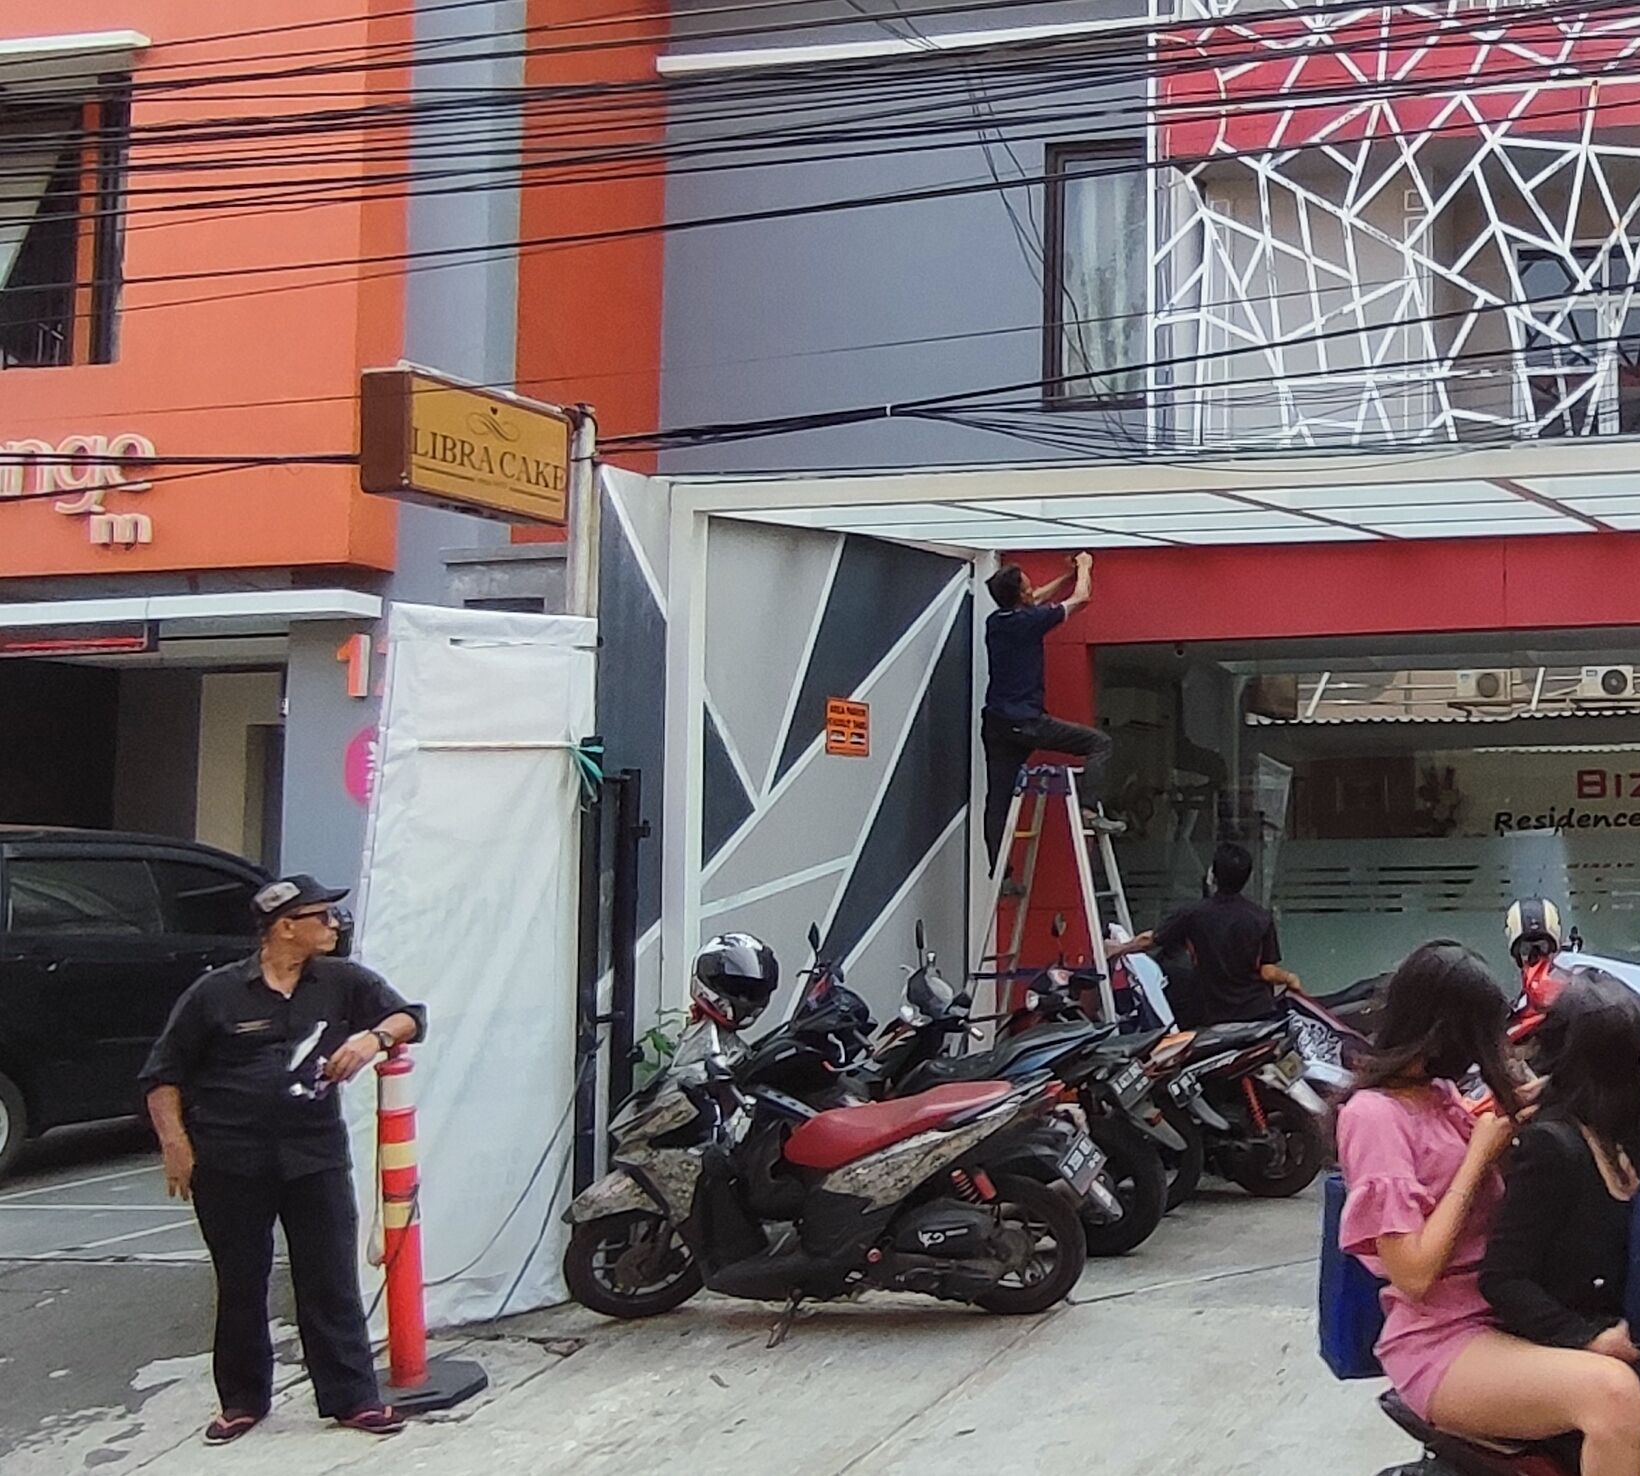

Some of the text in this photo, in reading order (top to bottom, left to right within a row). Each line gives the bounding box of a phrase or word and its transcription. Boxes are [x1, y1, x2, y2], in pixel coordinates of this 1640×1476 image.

[0, 433, 156, 515] nge
[412, 427, 566, 491] LIBRA CAKE
